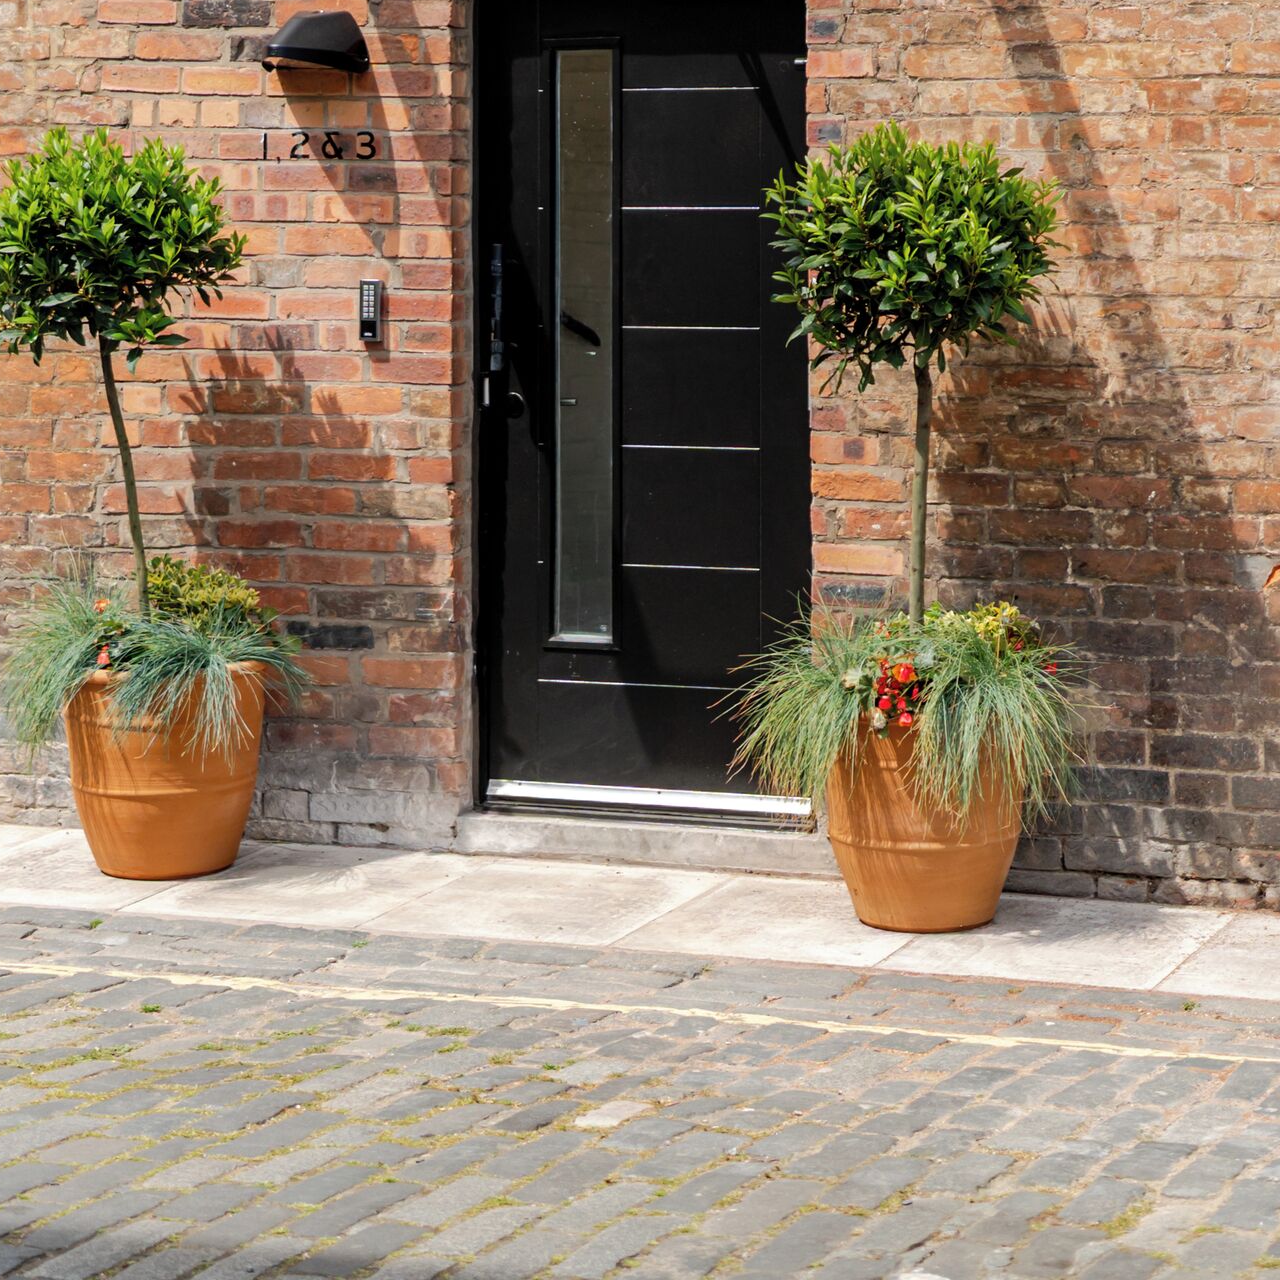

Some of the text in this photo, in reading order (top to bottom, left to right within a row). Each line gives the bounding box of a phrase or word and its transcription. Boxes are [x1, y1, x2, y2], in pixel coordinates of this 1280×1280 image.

[290, 131, 310, 159] 2
[321, 131, 343, 160] &
[356, 131, 376, 160] 3
